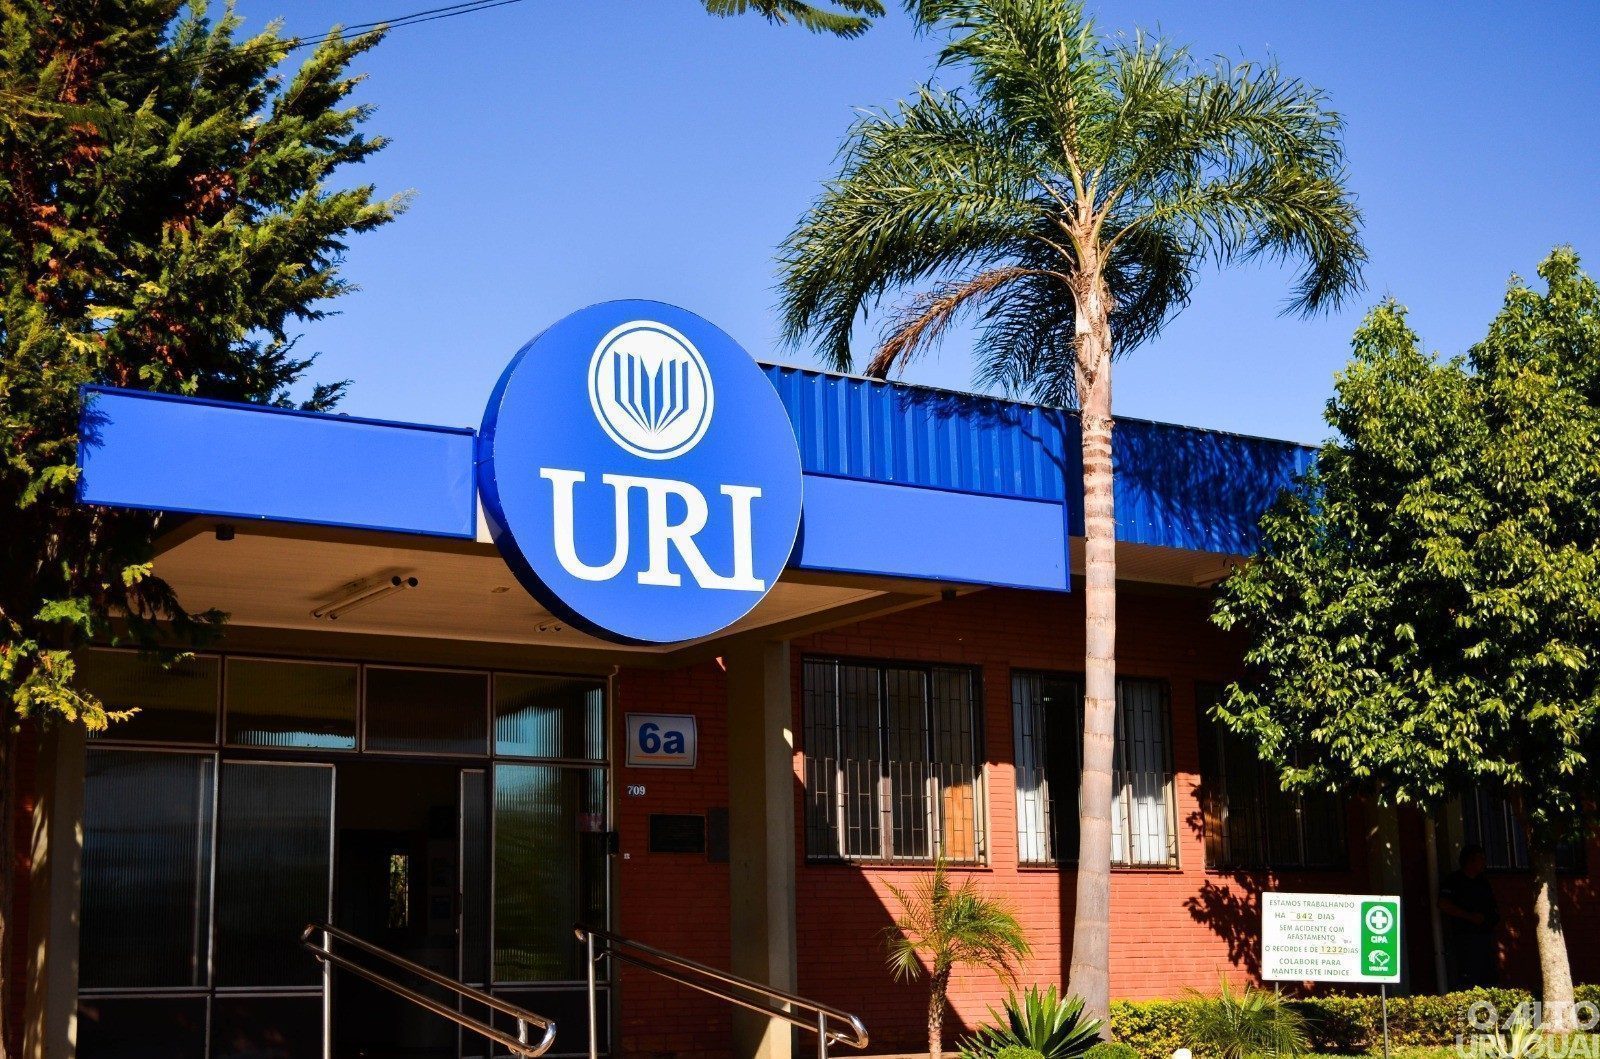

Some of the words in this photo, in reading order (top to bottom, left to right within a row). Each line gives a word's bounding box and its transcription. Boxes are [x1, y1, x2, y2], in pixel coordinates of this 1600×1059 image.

[539, 467, 766, 592] URI
[638, 722, 685, 755] 6a
[627, 785, 646, 796] 709
[1269, 899, 1301, 907] ESTAMOS
[1303, 900, 1355, 909] TRABALHANDO
[1296, 912, 1313, 920] 842
[1286, 933, 1336, 941] AFASTAMENTO
[1370, 935, 1389, 944] CIPA
[1278, 957, 1319, 966] COLABORE
[1305, 968, 1322, 976] ESTE
